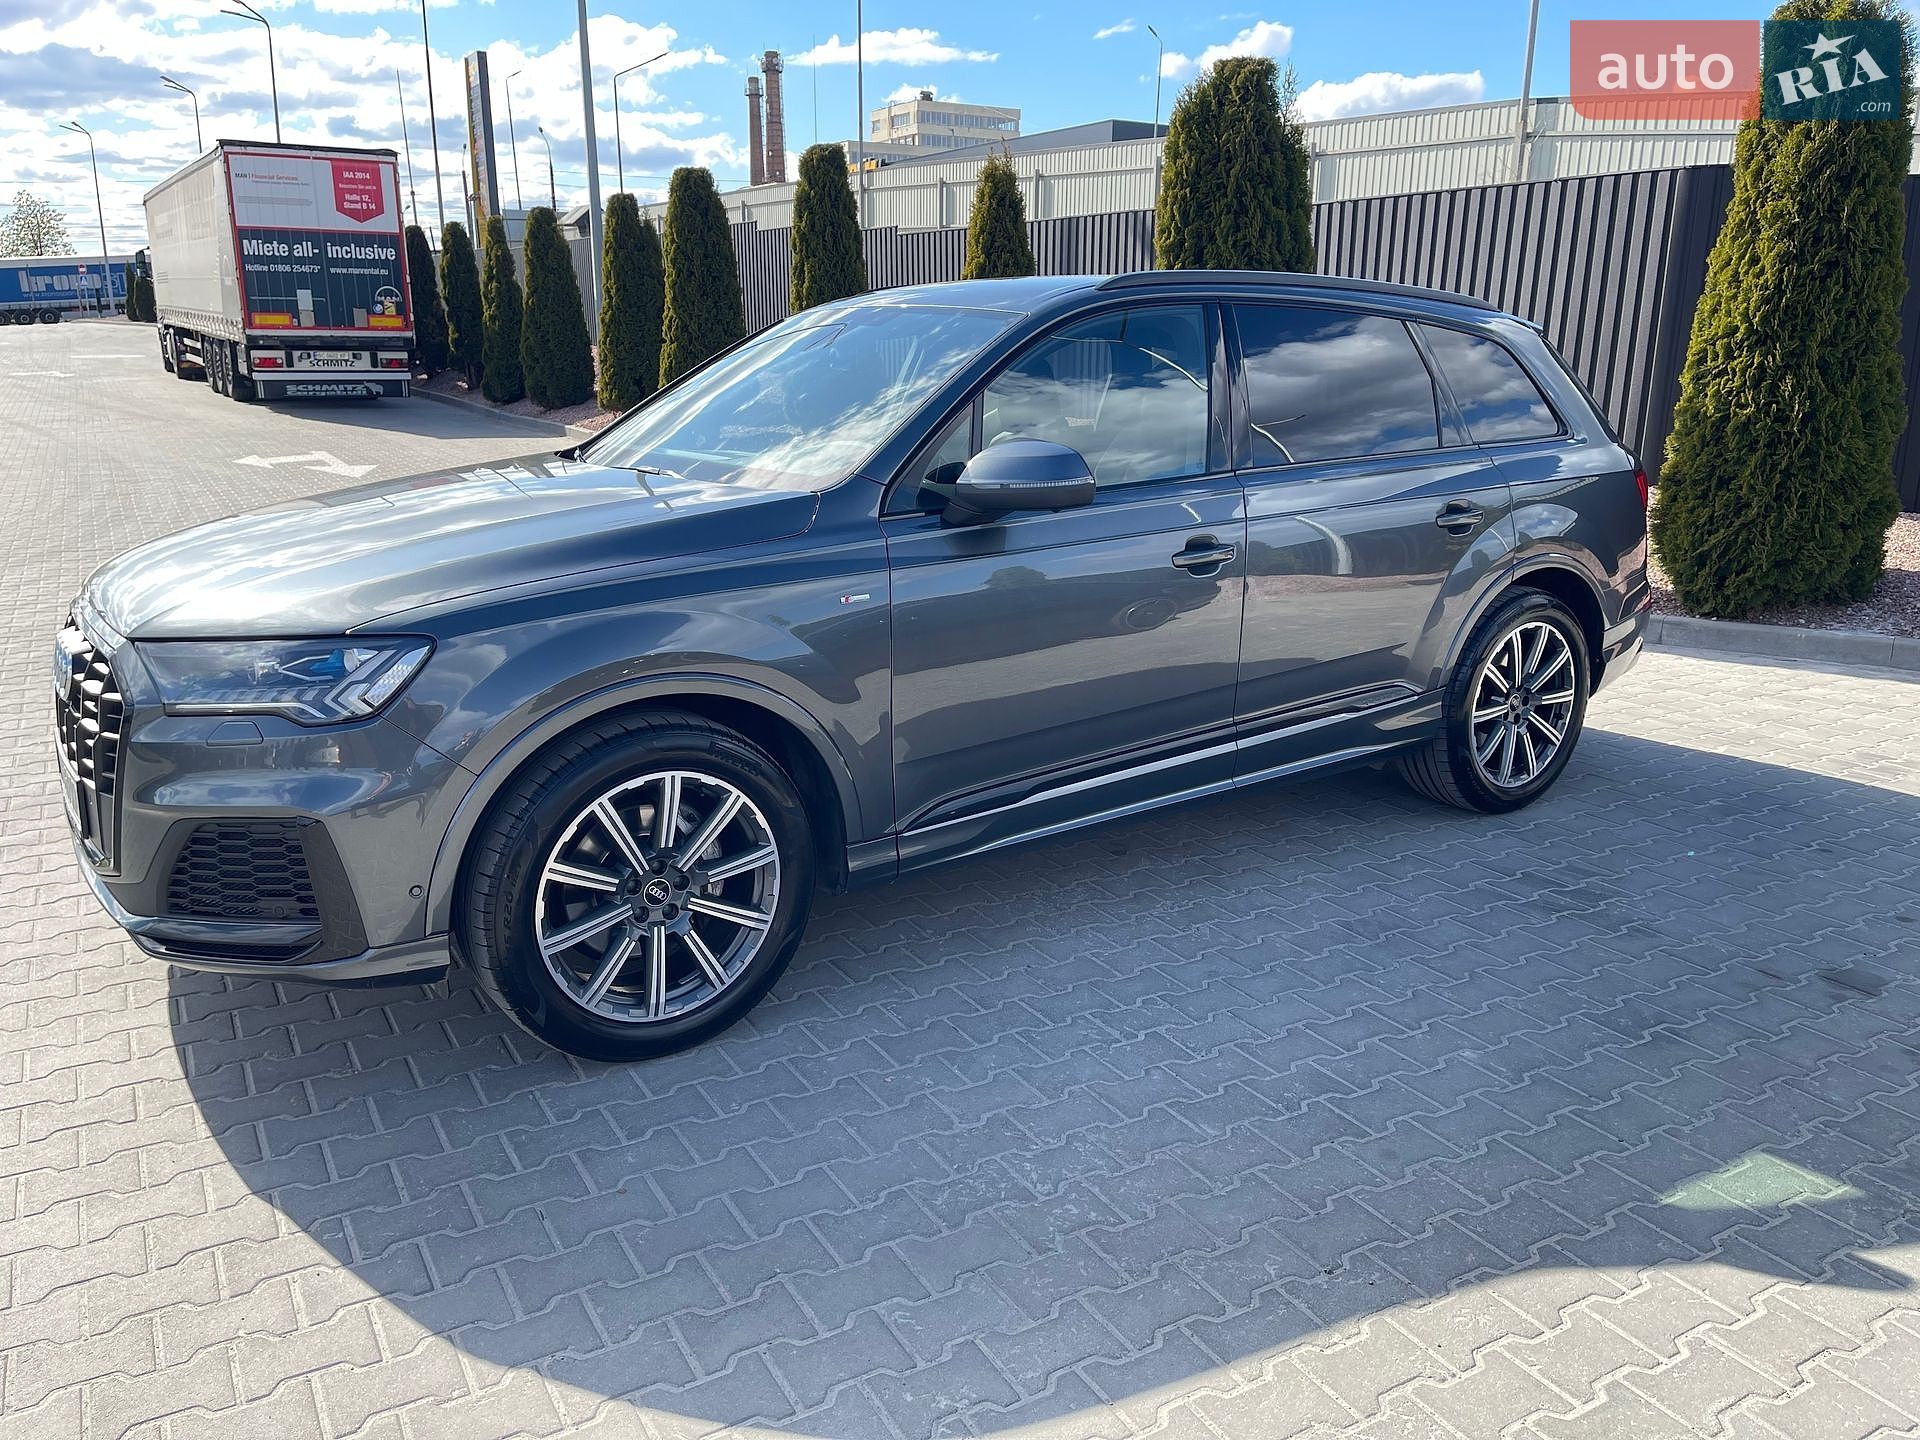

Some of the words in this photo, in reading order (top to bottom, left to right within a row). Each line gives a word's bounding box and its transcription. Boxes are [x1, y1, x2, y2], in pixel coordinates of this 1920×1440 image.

[354, 171, 370, 180] 2014
[242, 239, 289, 257] Miete
[293, 241, 320, 258] all-
[326, 242, 397, 261] inclusive
[245, 263, 269, 273] Hotline
[309, 359, 356, 368] SCHMITZ
